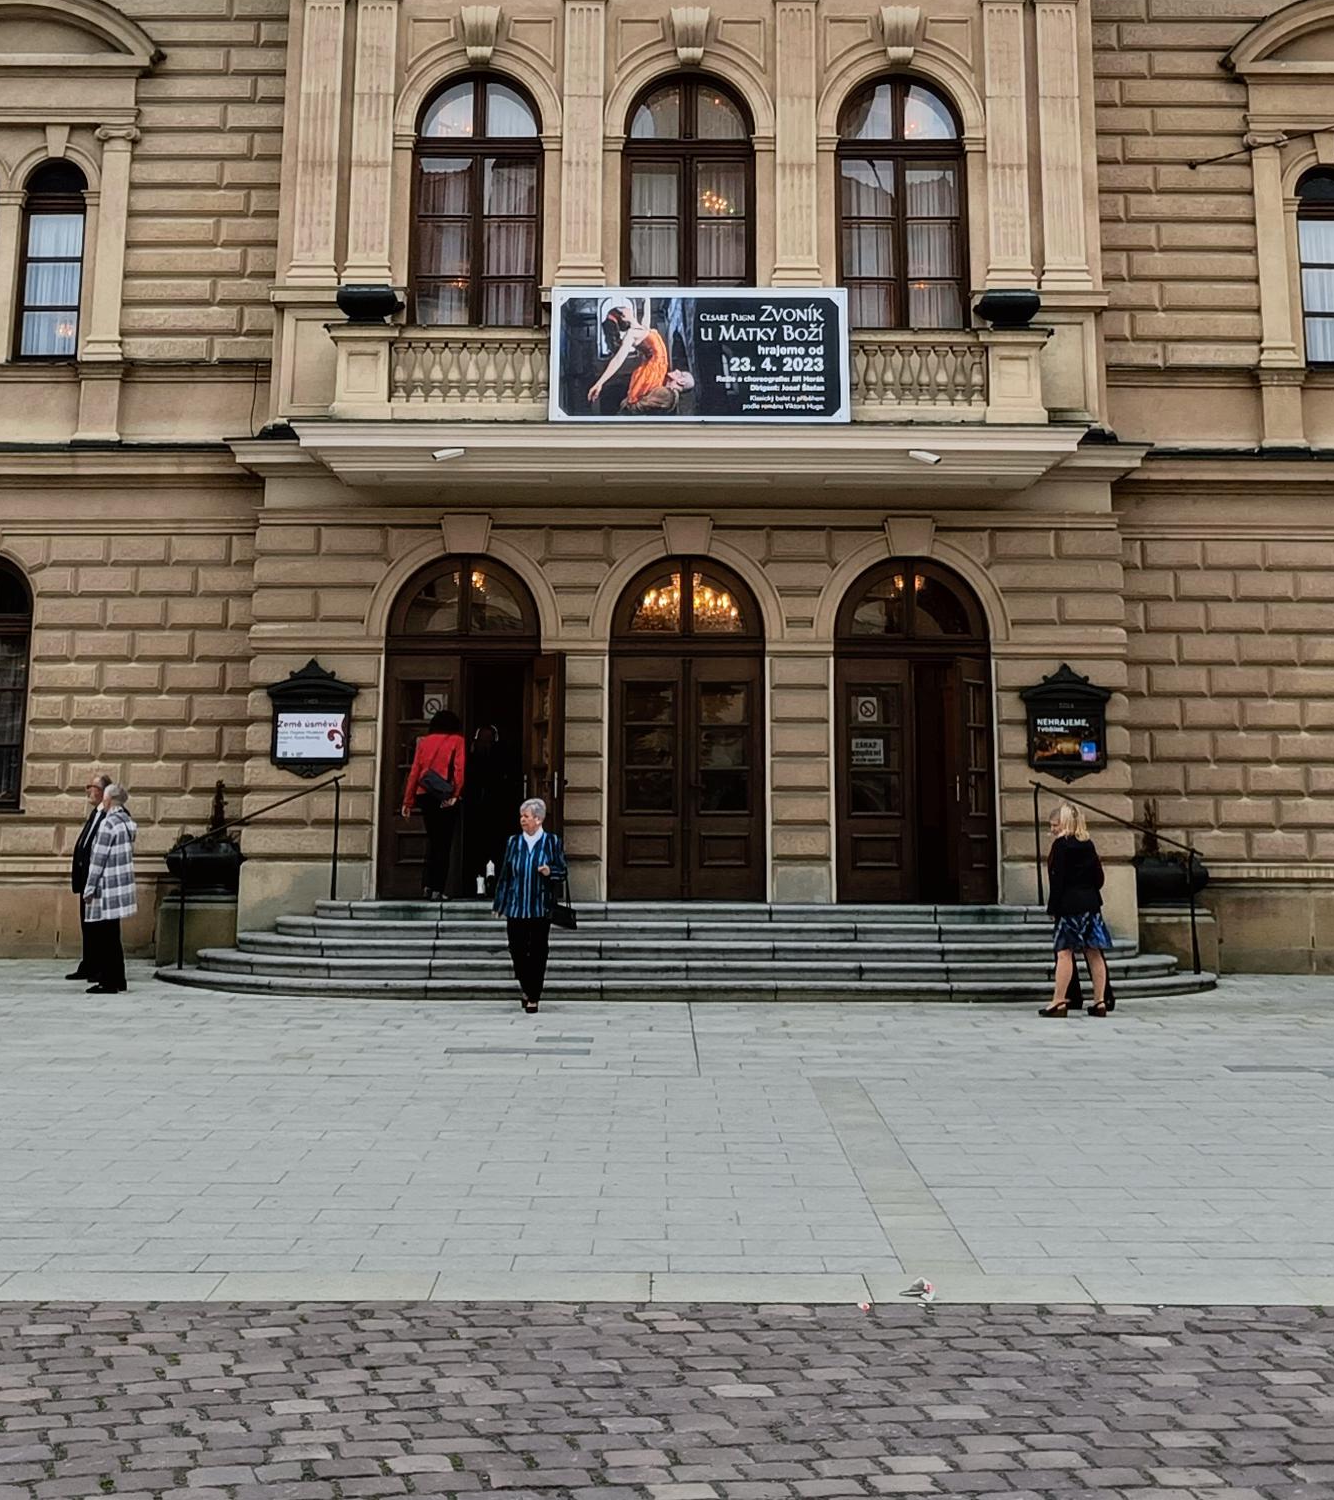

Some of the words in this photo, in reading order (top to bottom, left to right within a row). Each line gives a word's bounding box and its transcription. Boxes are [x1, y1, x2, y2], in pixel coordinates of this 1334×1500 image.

[757, 344, 805, 357] hrajeme
[808, 344, 824, 355] od
[729, 357, 756, 372] 23.
[761, 357, 777, 372] 4.
[782, 357, 824, 372] 2023
